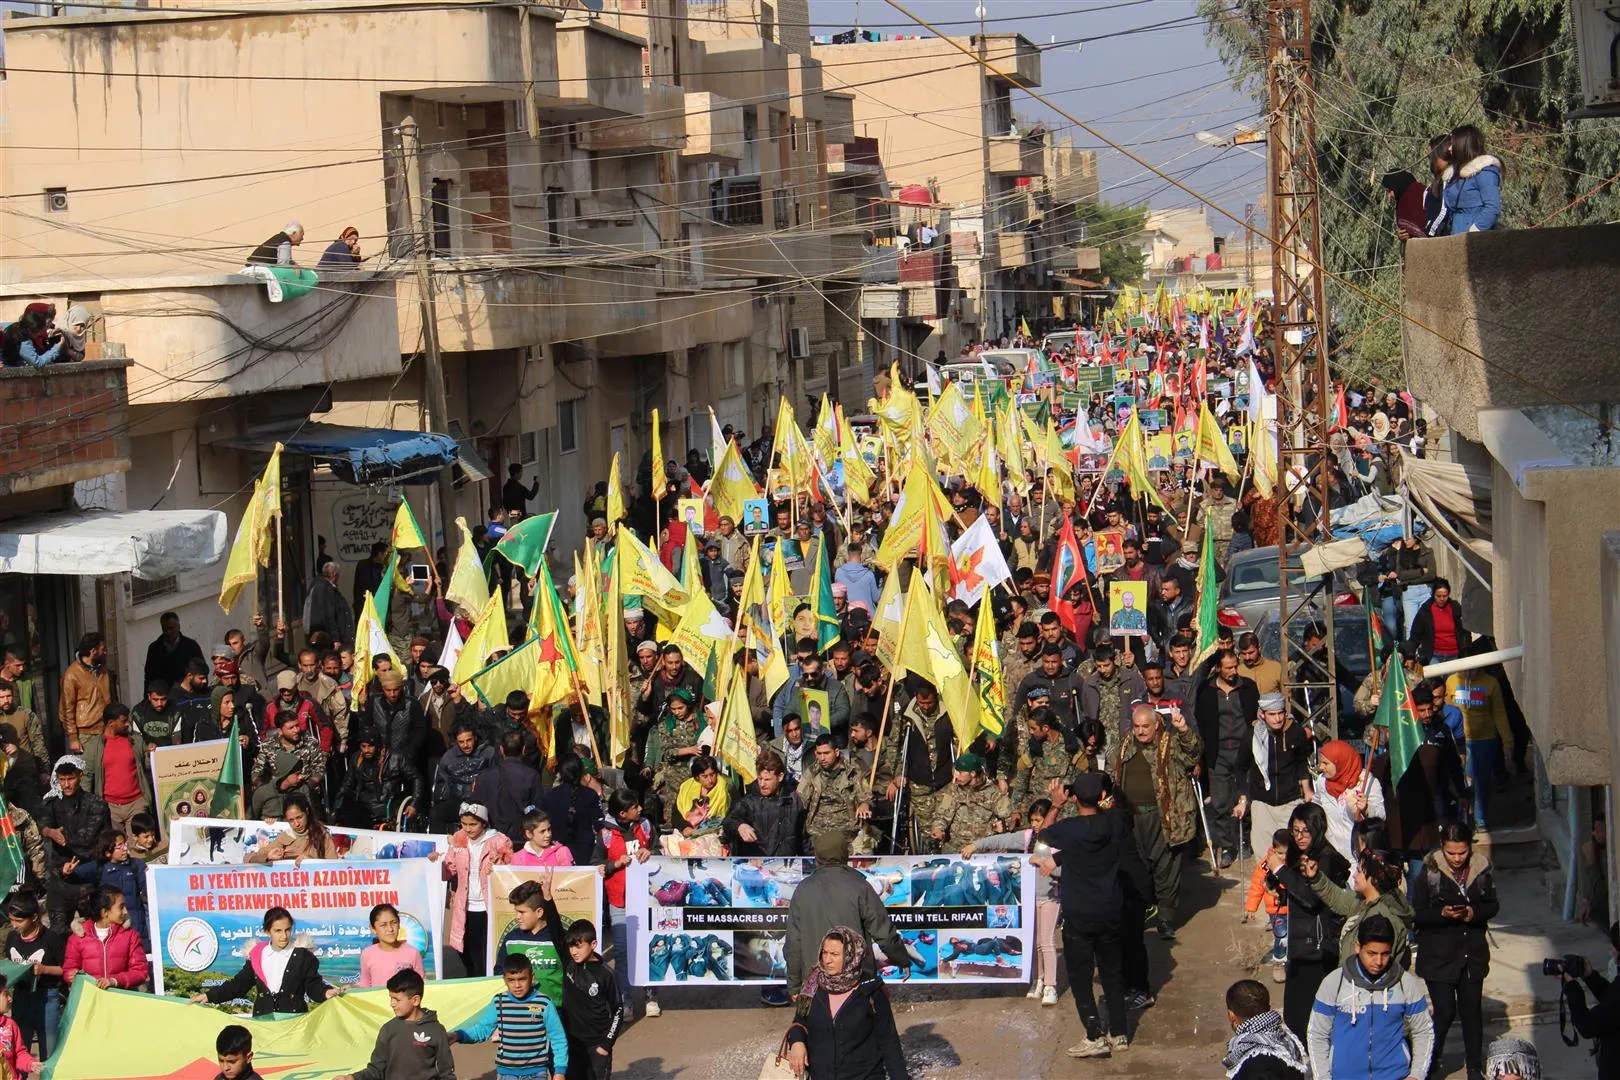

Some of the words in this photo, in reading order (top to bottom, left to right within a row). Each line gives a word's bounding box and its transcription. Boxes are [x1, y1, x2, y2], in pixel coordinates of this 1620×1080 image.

[189, 874, 205, 890] BI
[207, 869, 267, 889] YEKÎTIYA
[270, 867, 310, 888] GELÊN
[313, 865, 391, 887] AZADÎXWEZ
[187, 892, 215, 912] EMÊ
[218, 888, 309, 911] BERXWEDANÊ
[311, 890, 357, 909] BILIND
[360, 890, 399, 908] BIKIN
[686, 914, 704, 923] THE
[707, 914, 763, 923] MASSACRES
[766, 914, 779, 923] OF
[888, 913, 912, 923] TATE
[914, 913, 925, 922] IN
[926, 913, 949, 922] TELL
[951, 912, 984, 921] RIFAAT
[220, 925, 253, 941] للحرية
